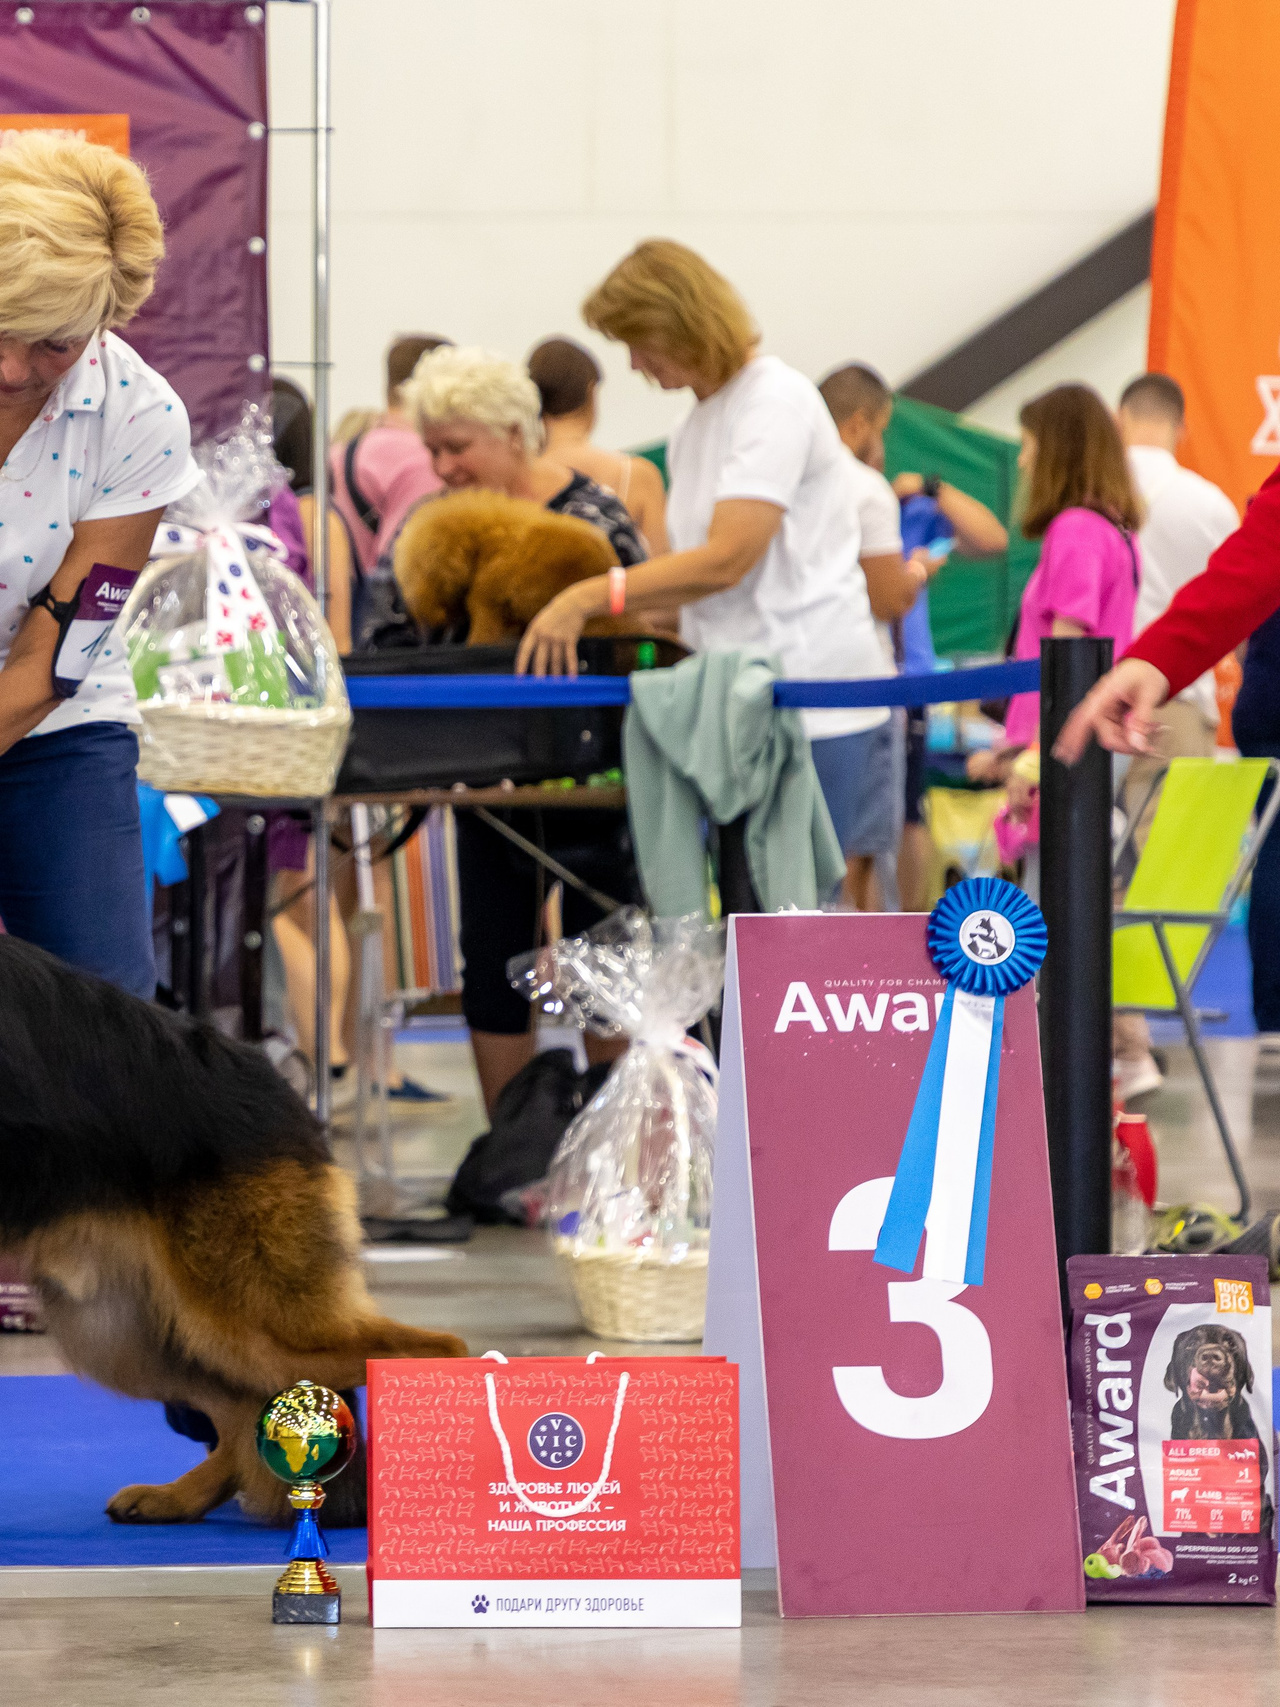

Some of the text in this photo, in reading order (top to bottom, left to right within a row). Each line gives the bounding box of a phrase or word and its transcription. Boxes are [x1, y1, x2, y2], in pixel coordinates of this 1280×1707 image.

[824, 979, 873, 987] QUALITY
[1217, 1281, 1249, 1295] 100%
[828, 1175, 993, 1439] 3
[1219, 1294, 1250, 1311] BIO
[1084, 1331, 1095, 1464] QUALITY FOR CHAMPIONS
[1084, 1312, 1136, 1511] Award
[1168, 1447, 1221, 1456] ALL BREED
[1169, 1468, 1200, 1477] ADULT
[1195, 1490, 1222, 1500] LAMB
[499, 1501, 510, 1513] И
[487, 1519, 626, 1532] НАША ПРОФЕССИЯ
[1227, 1573, 1237, 1584] 2
[496, 1596, 645, 1613] ПОДАРИ ДРУГУ ЗДОРОВЬЕ
